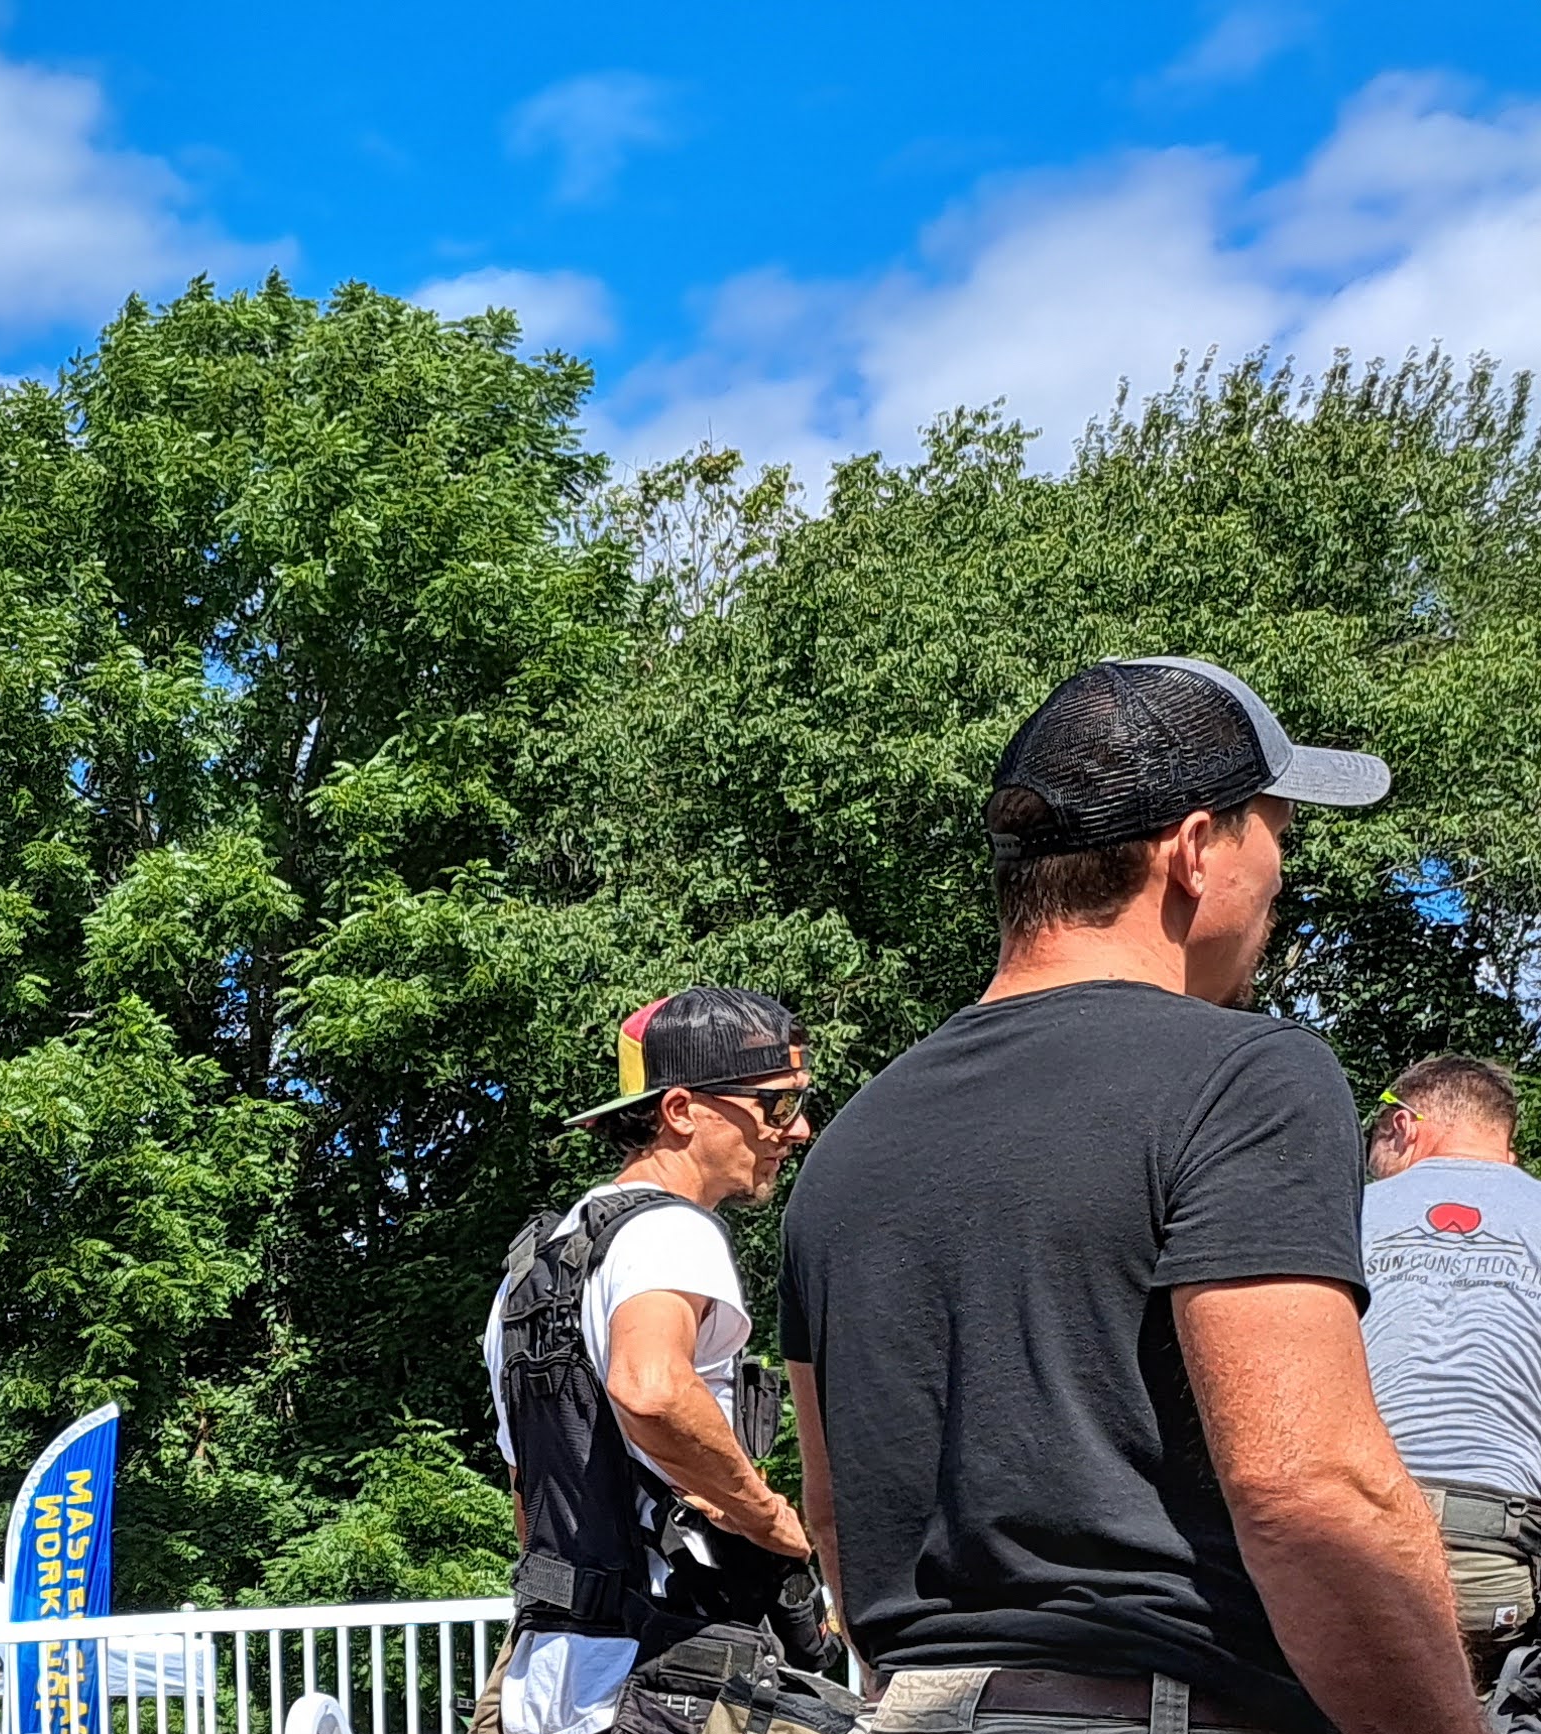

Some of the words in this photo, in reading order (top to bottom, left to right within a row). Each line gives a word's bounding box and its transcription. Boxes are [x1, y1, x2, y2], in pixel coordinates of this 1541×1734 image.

[1366, 1254, 1405, 1276] SUN
[1410, 1253, 1541, 1283] CONSTRUCTI
[66, 1469, 95, 1621] MASTE
